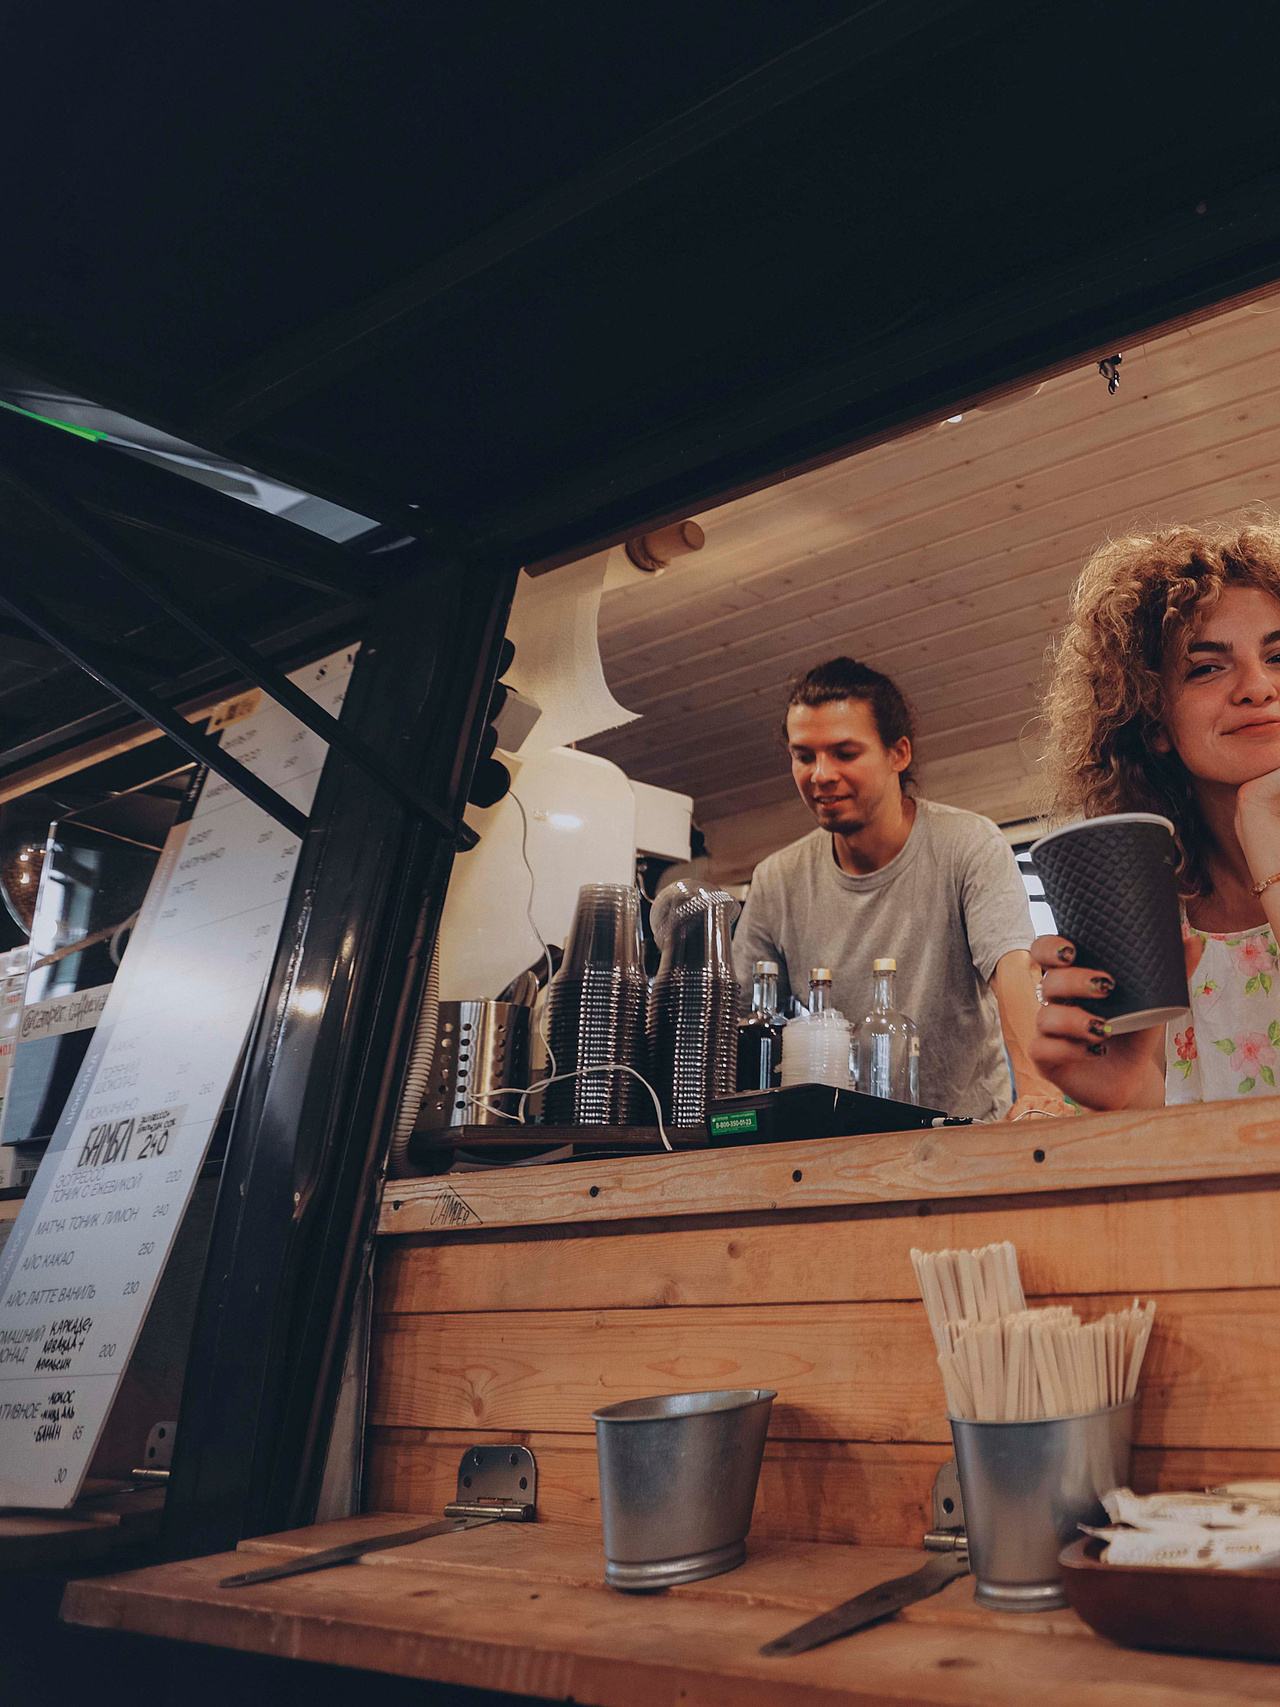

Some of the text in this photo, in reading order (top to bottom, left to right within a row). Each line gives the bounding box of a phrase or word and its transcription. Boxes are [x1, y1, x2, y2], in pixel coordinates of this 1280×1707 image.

[65, 1053, 99, 1126] ШОКОЛАД
[136, 1129, 169, 1161] 240
[50, 1169, 183, 1203] ТОНИК С ЕЖЕВИКОЙ 220
[34, 1203, 170, 1236] МАТЧА ТОНИК ЛИМОН 240
[430, 1190, 470, 1226] CAMPER
[19, 1241, 155, 1271] АЙС КАКАО 250
[4, 1281, 140, 1308] АЙС ЛАТТЕ ВАНИЛЬ 230
[98, 1343, 117, 1358] 200
[72, 1425, 85, 1441] 65
[54, 1467, 68, 1484] 30
